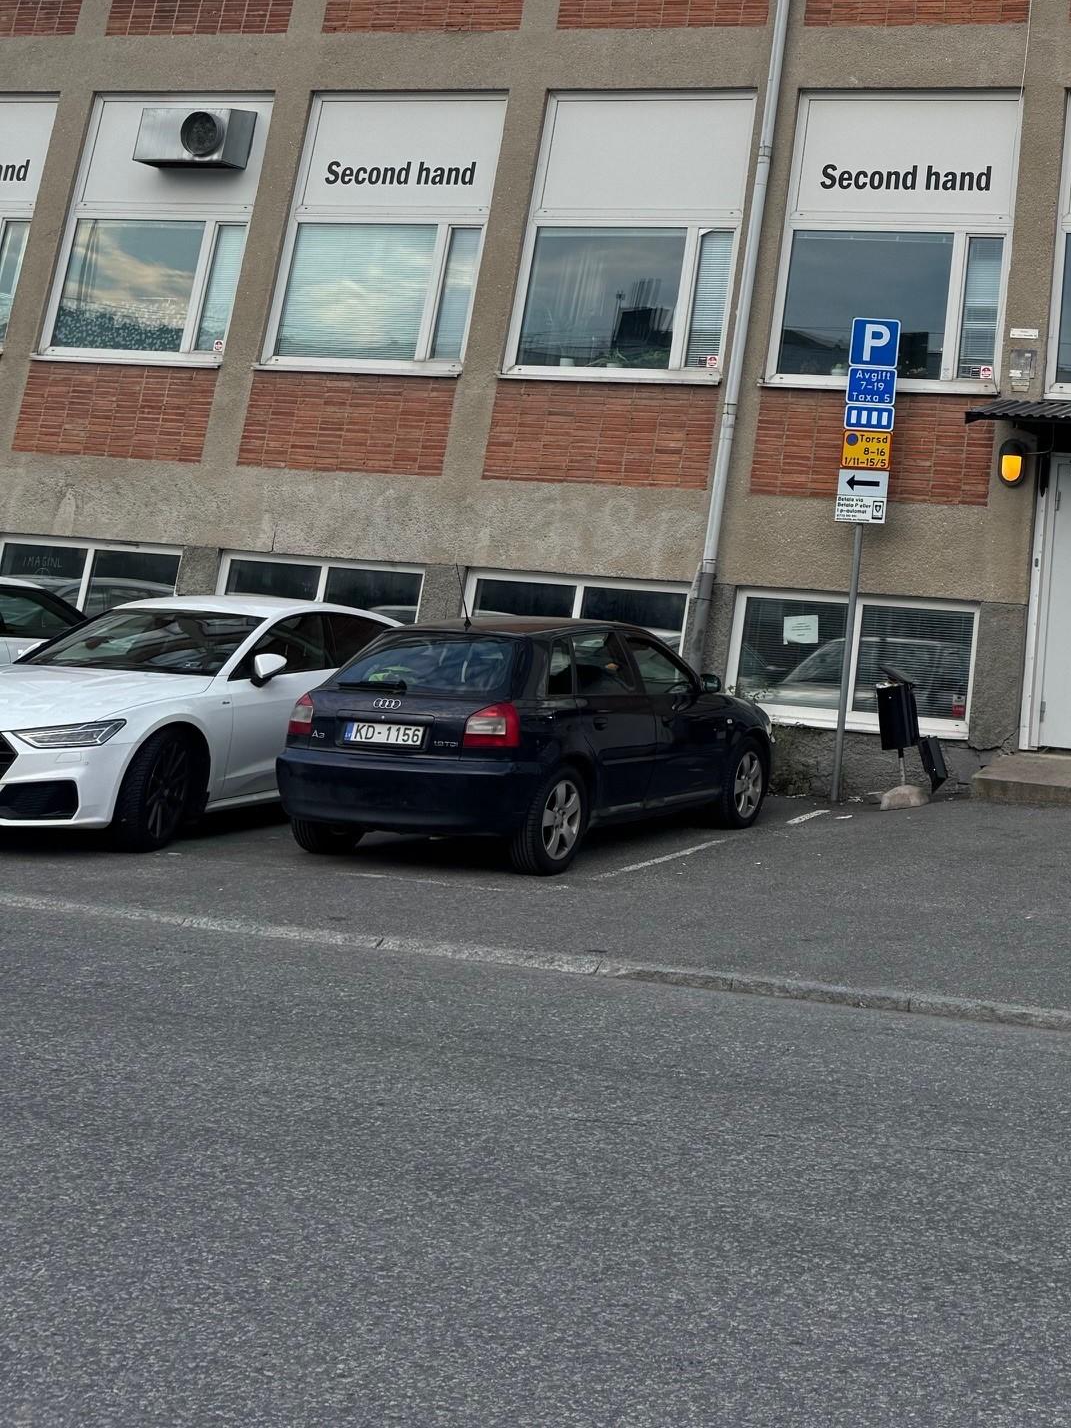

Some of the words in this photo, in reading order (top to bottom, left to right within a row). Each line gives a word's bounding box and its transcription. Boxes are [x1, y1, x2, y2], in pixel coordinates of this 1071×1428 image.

[0, 159, 30, 182] nd
[324, 160, 412, 186] Second
[416, 161, 477, 186] hand
[819, 163, 918, 191] Second
[925, 165, 993, 192] hand
[863, 323, 891, 361] P
[855, 370, 891, 382] Avgift
[860, 381, 885, 391] 7-19
[852, 392, 879, 402] Taxa
[884, 394, 891, 403] 5
[859, 434, 888, 444] Torsd
[863, 447, 886, 457] 8-16
[844, 456, 887, 467] 1/11-15/5
[312, 730, 326, 739] A3
[354, 724, 420, 743] KD-1156
